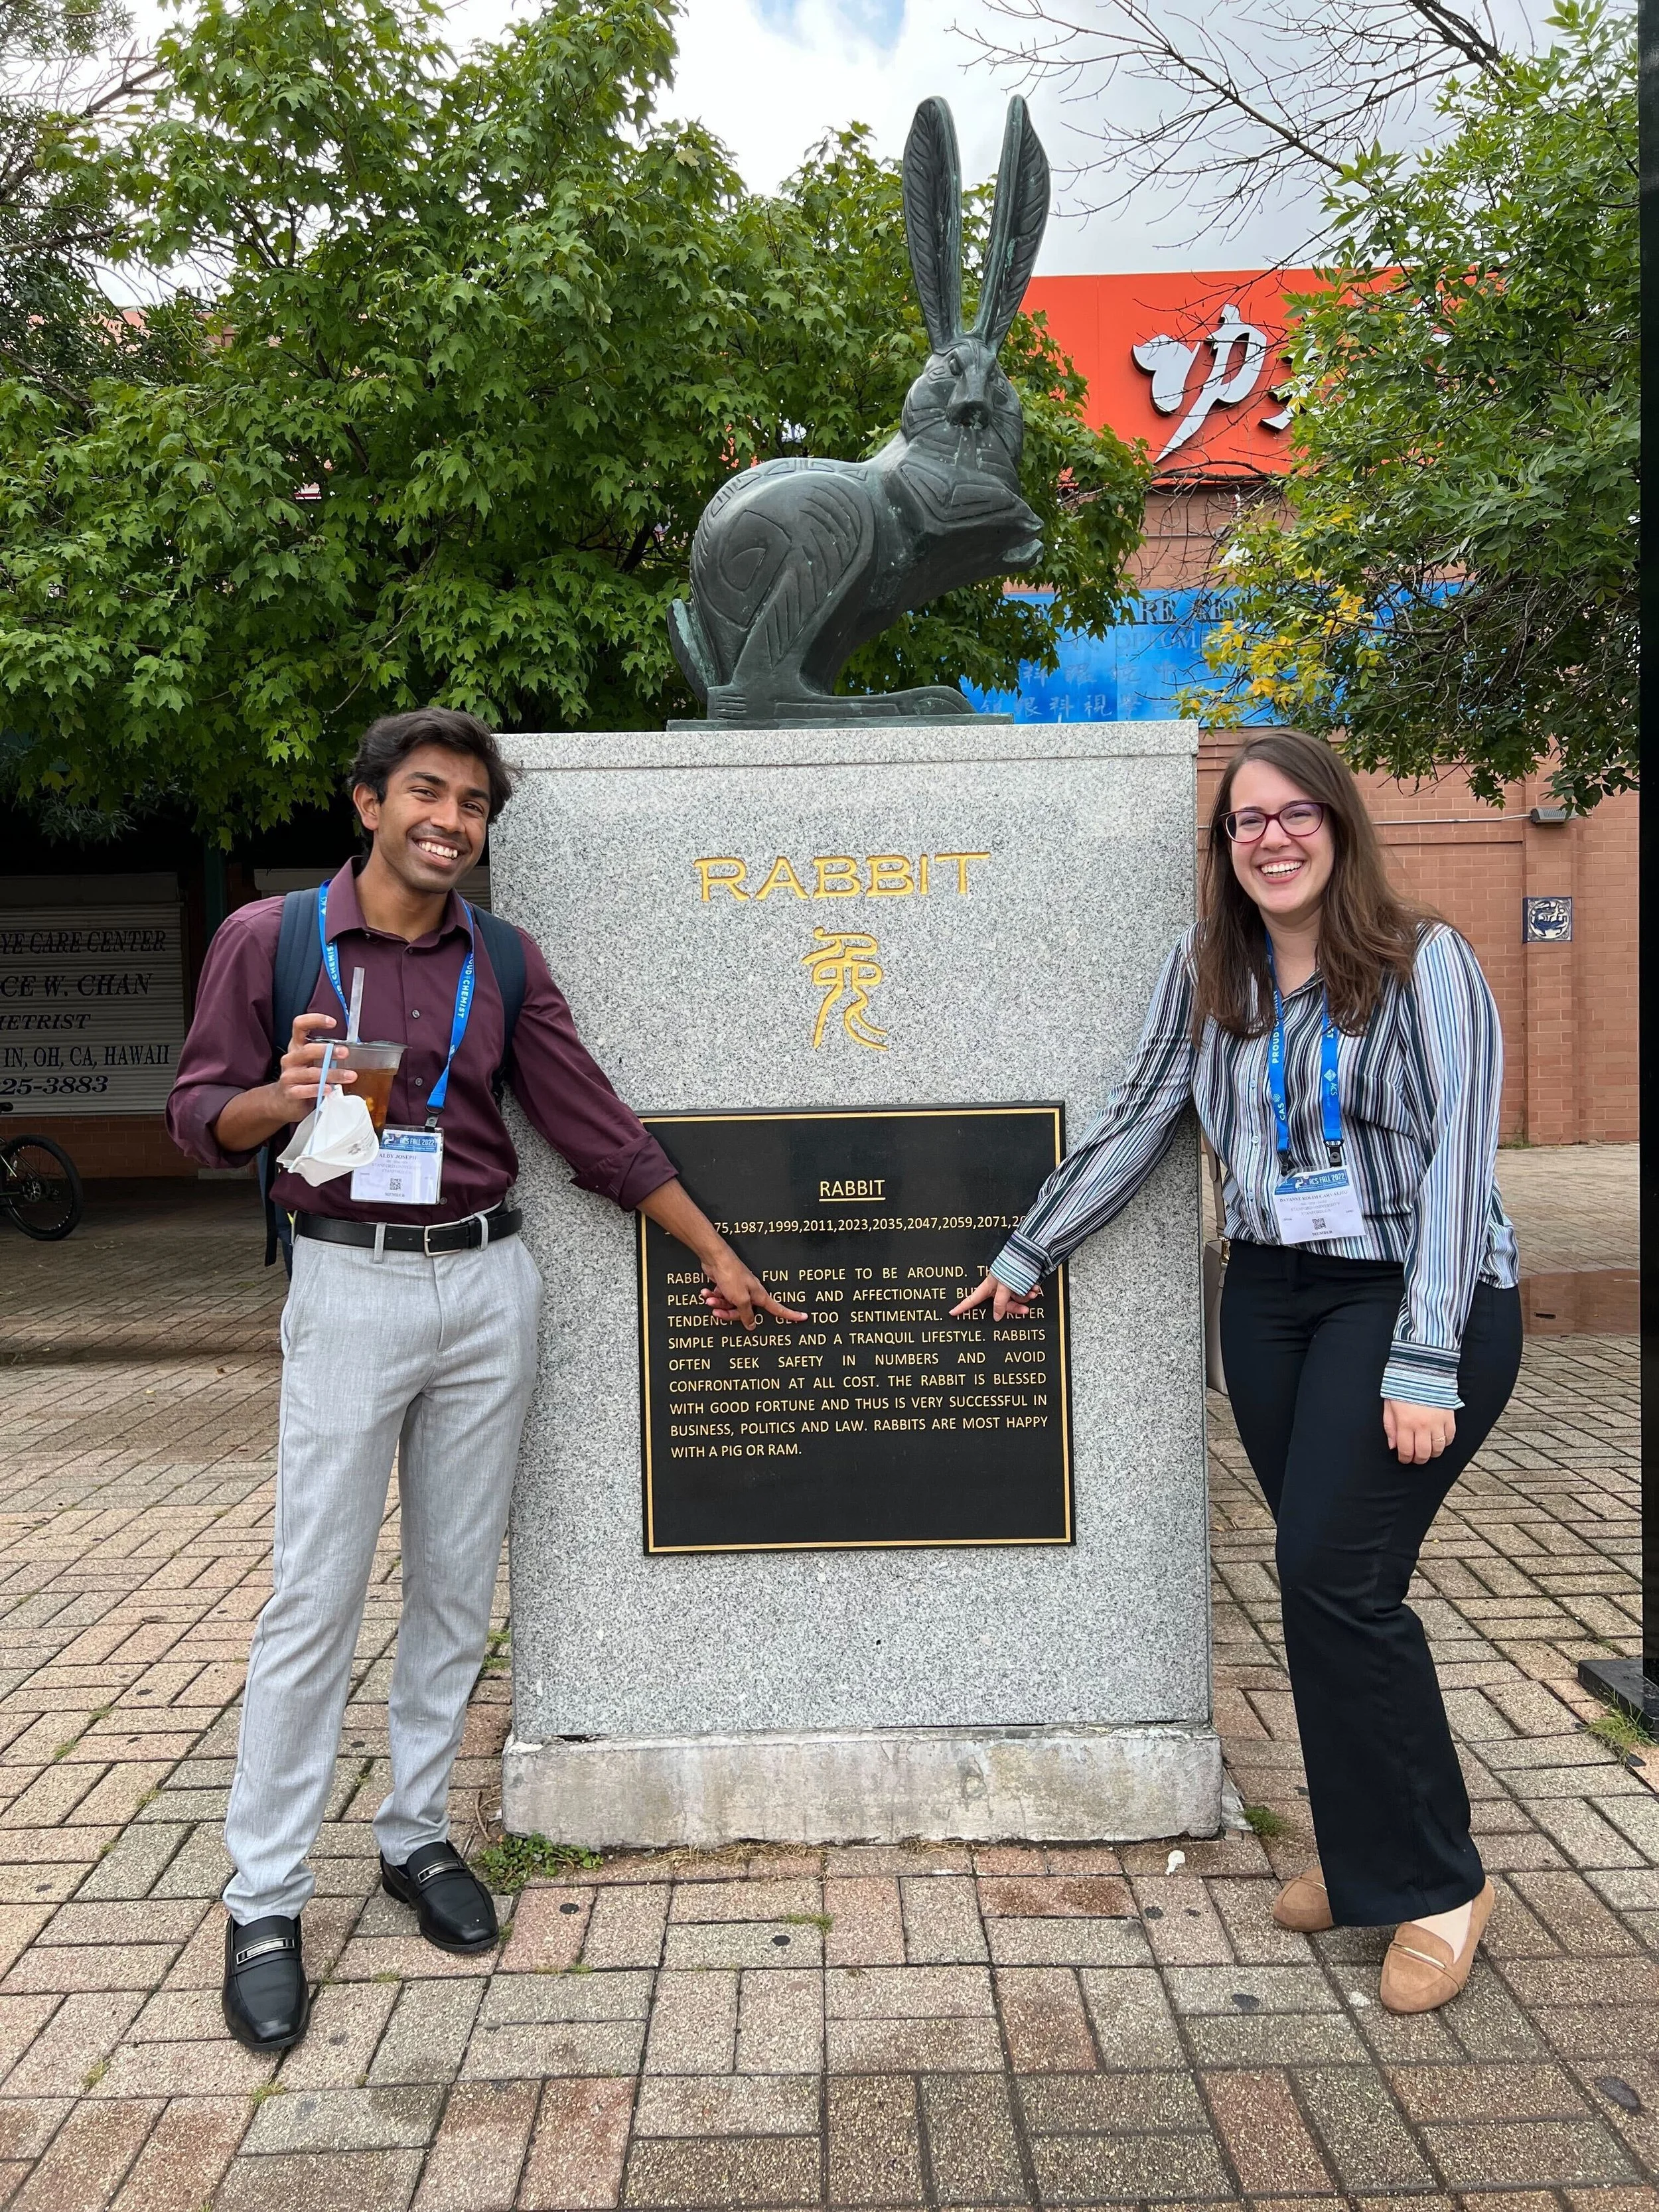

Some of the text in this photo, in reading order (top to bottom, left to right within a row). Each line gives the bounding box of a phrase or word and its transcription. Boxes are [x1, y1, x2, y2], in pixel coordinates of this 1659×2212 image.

[693, 851, 991, 902] RABBIT
[30, 931, 82, 953] CARE
[88, 930, 167, 952] CENTER
[326, 942, 338, 981] CHEMIS
[44, 975, 69, 997] W.
[78, 973, 154, 995] CHAN
[457, 980, 471, 1019] CHEMIST
[4, 1045, 170, 1070] IN, OH, CA, HAWAII
[0, 1075, 108, 1095] 25-3883
[820, 1179, 885, 1196] RABBIT
[1319, 1175, 1331, 1184] FALL
[1331, 1172, 1345, 1182] 2022
[667, 1272, 710, 1284] RABBIT
[762, 1270, 789, 1282] FUN
[799, 1268, 846, 1281] PEOPLE
[855, 1268, 873, 1280] TO
[883, 1267, 898, 1279] BE
[907, 1266, 968, 1279] AROUND.
[816, 1290, 843, 1301] AND
[853, 1288, 946, 1301] AFFECTIONATE
[956, 1288, 977, 1299] BU
[668, 1315, 733, 1328] TENDENC
[755, 1313, 763, 1325] O
[811, 1311, 839, 1323] TOO
[850, 1309, 943, 1323] SENTIMENTAL.
[668, 1329, 1046, 1349] SIMPLE PLEASURES AND A TRANQUIL LIFESTYLE. RABBITS
[668, 1351, 1046, 1371] OFTEN SEEK SAFETY IN NUMBERS AND AVOID
[669, 1372, 1046, 1392] CONFRONTATION AT ALL COST. THE RABBIT IS BLESSED
[670, 1394, 1047, 1415] WITH GOOD FORTUNE AND THUS IS VERY SUCCESSFUL IN
[670, 1416, 1048, 1438] BUSINESS, POLITICS AND LAW. RABBITS ARE MOST HAPPY
[670, 1443, 802, 1458] WITH A PIG OR RAM.
